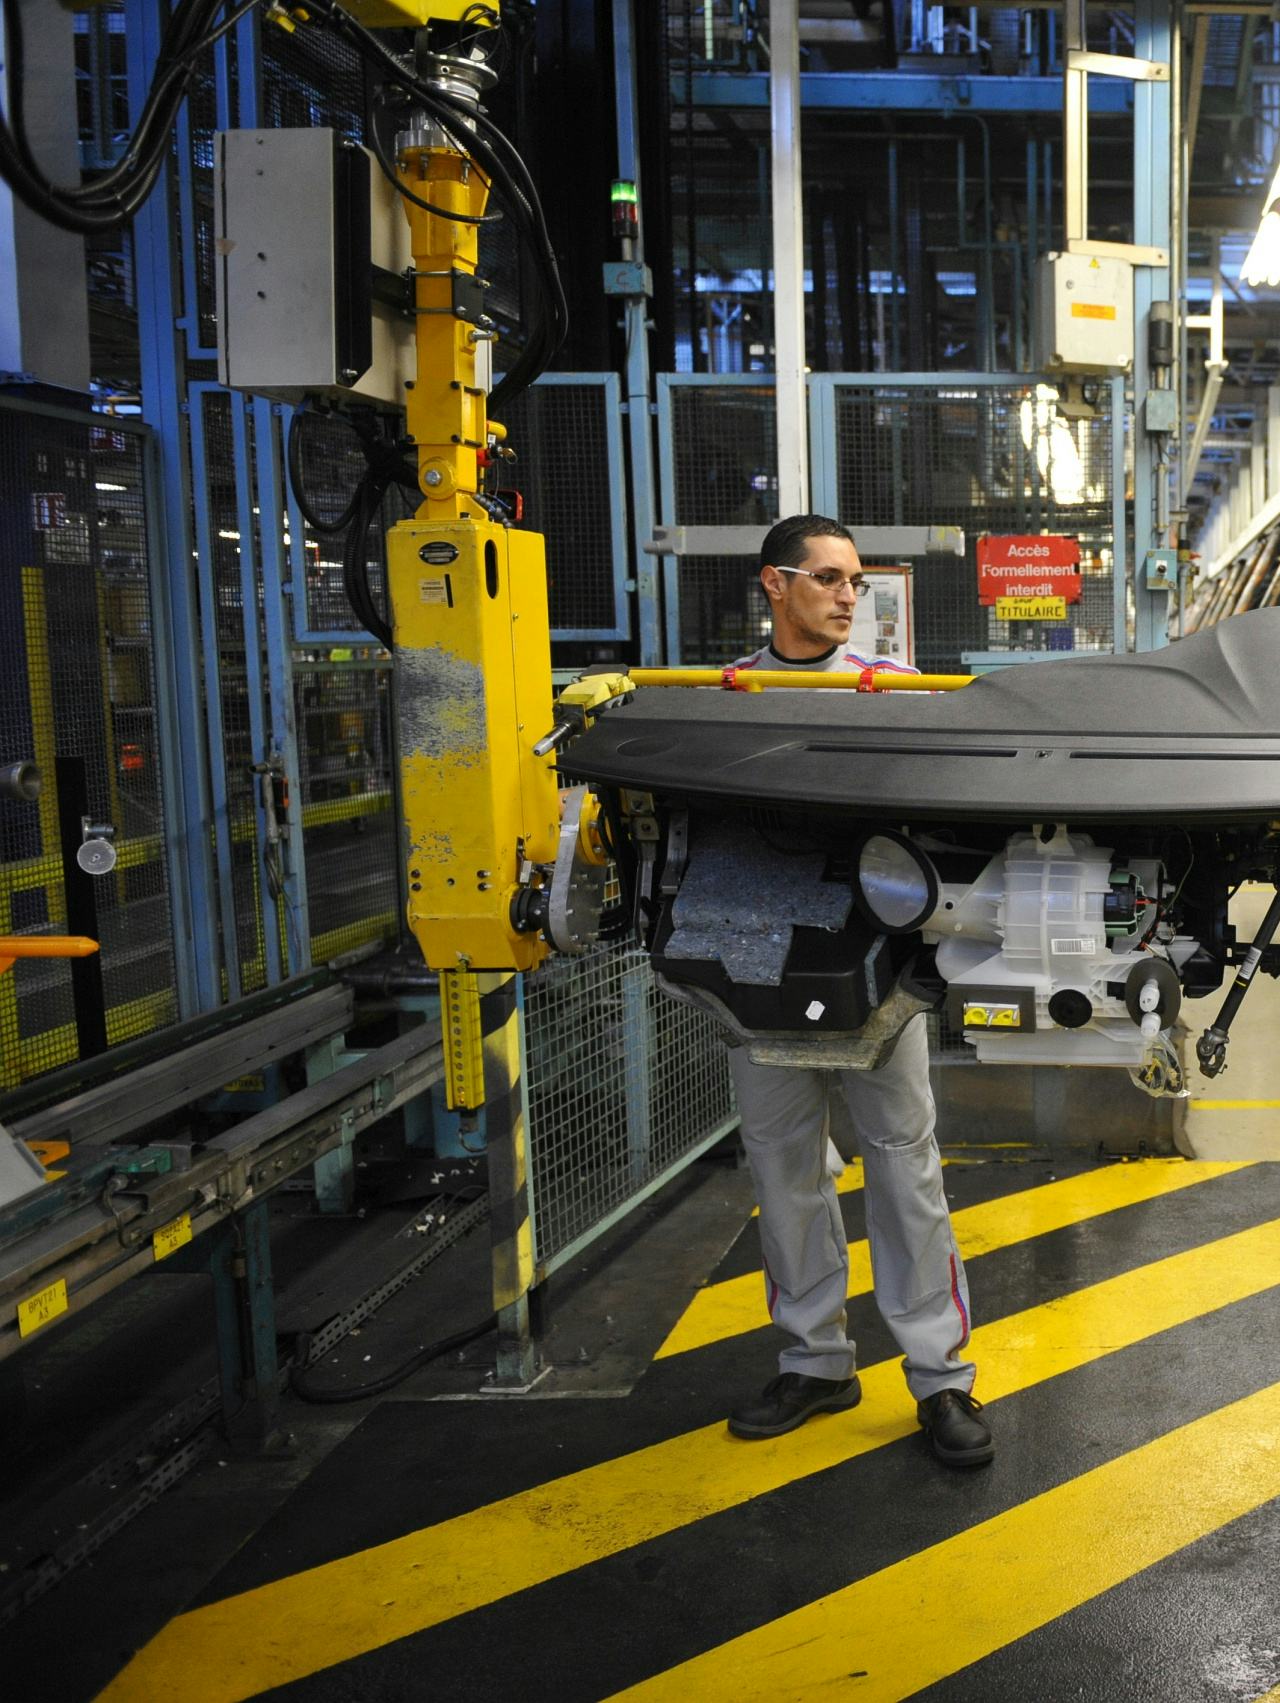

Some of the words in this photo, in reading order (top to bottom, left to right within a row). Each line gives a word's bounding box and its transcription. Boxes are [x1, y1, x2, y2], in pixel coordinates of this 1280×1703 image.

[1007, 544, 1050, 557] Accès
[981, 563, 1076, 577] Formellement
[1000, 606, 1062, 617] TITULAIRE
